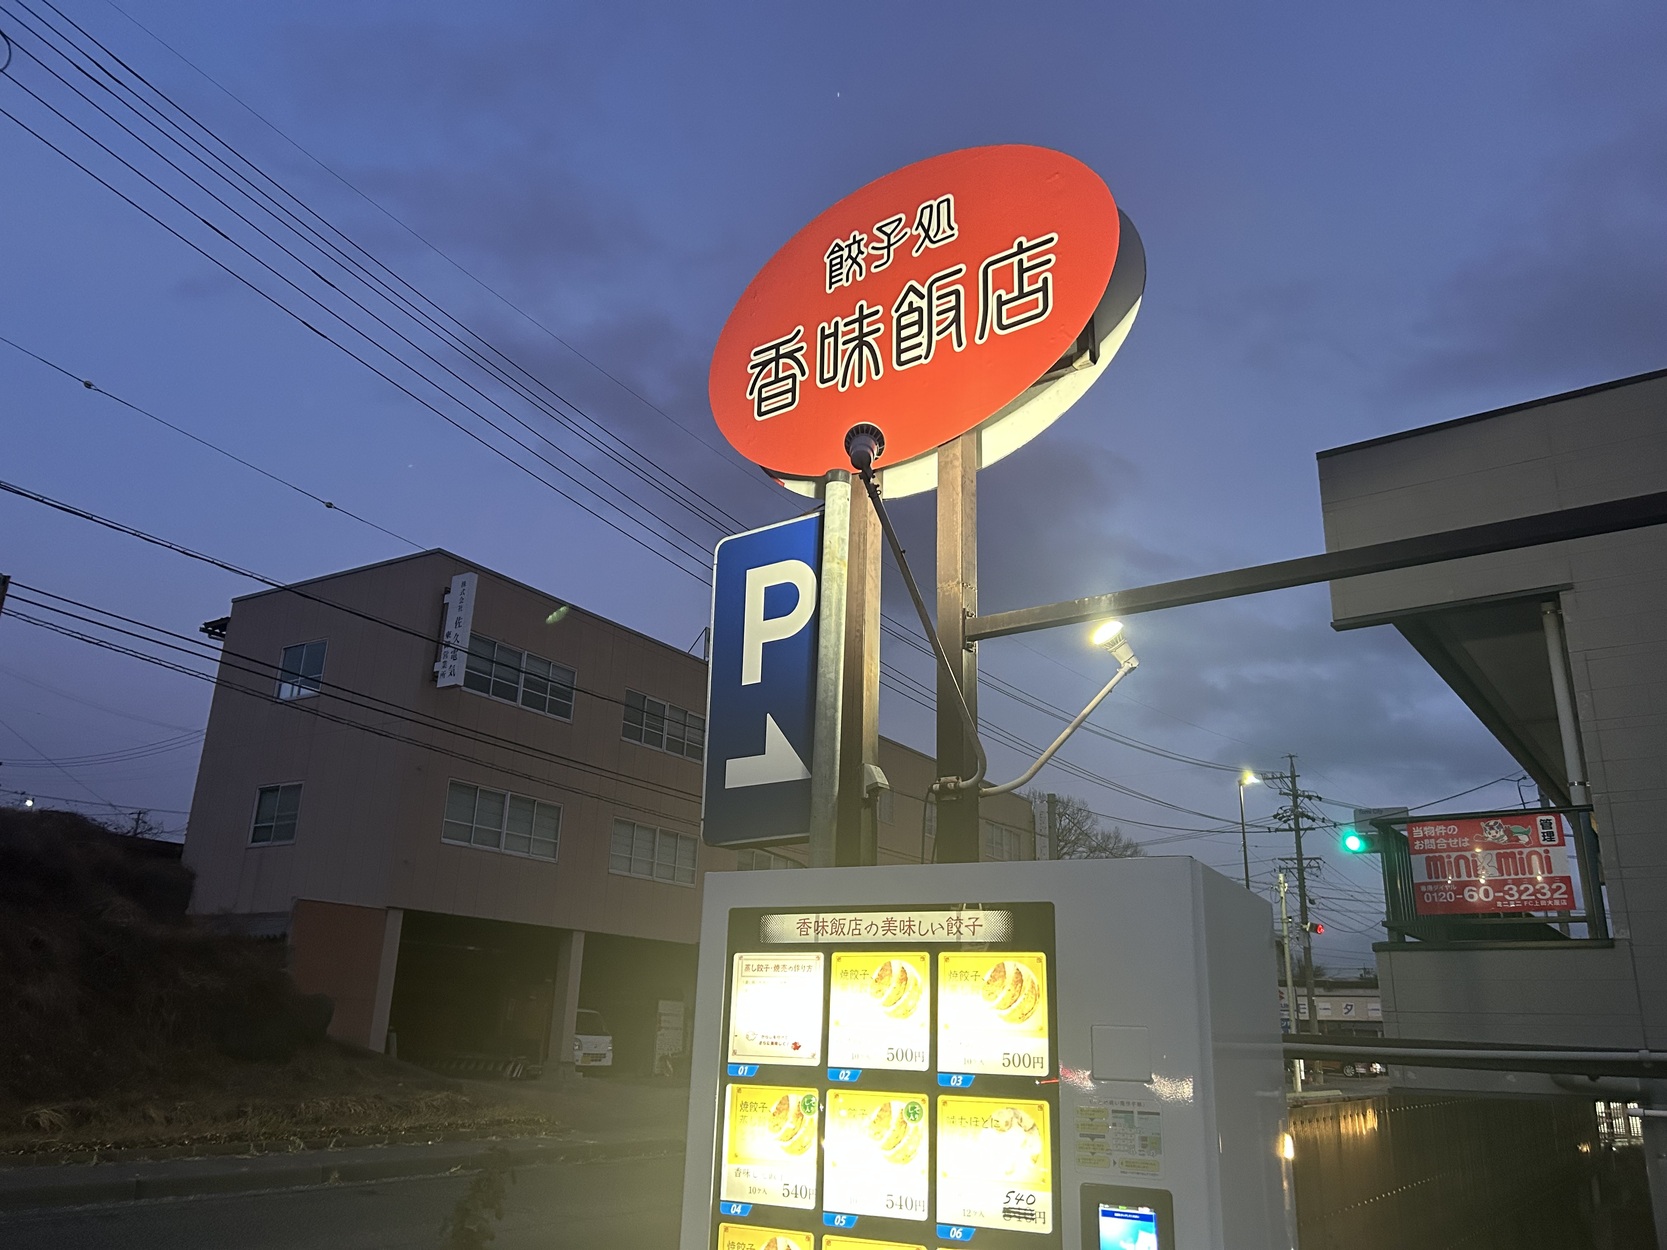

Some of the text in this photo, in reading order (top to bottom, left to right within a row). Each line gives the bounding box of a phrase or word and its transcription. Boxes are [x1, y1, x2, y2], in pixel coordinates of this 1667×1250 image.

[824, 194, 958, 292] 餃子処
[746, 232, 1058, 421] 香味飯店
[741, 559, 817, 686] P
[1412, 824, 1458, 838] 当物件の
[1538, 818, 1557, 843] 管理
[1413, 837, 1470, 850] お問合せは
[1423, 882, 1569, 903] 0120-60-3232
[796, 916, 984, 937] 香味飯店の美味しい餃子
[886, 1047, 925, 1063] 500円
[1002, 1052, 1044, 1069] 500円
[738, 1066, 749, 1075] 01
[839, 1070, 851, 1080] 02
[950, 1075, 963, 1086] 03
[886, 1194, 926, 1212] 540円
[1003, 1190, 1036, 1206] 540
[730, 1204, 742, 1215] 04
[834, 1215, 847, 1226] 05
[949, 1227, 963, 1239] 06
